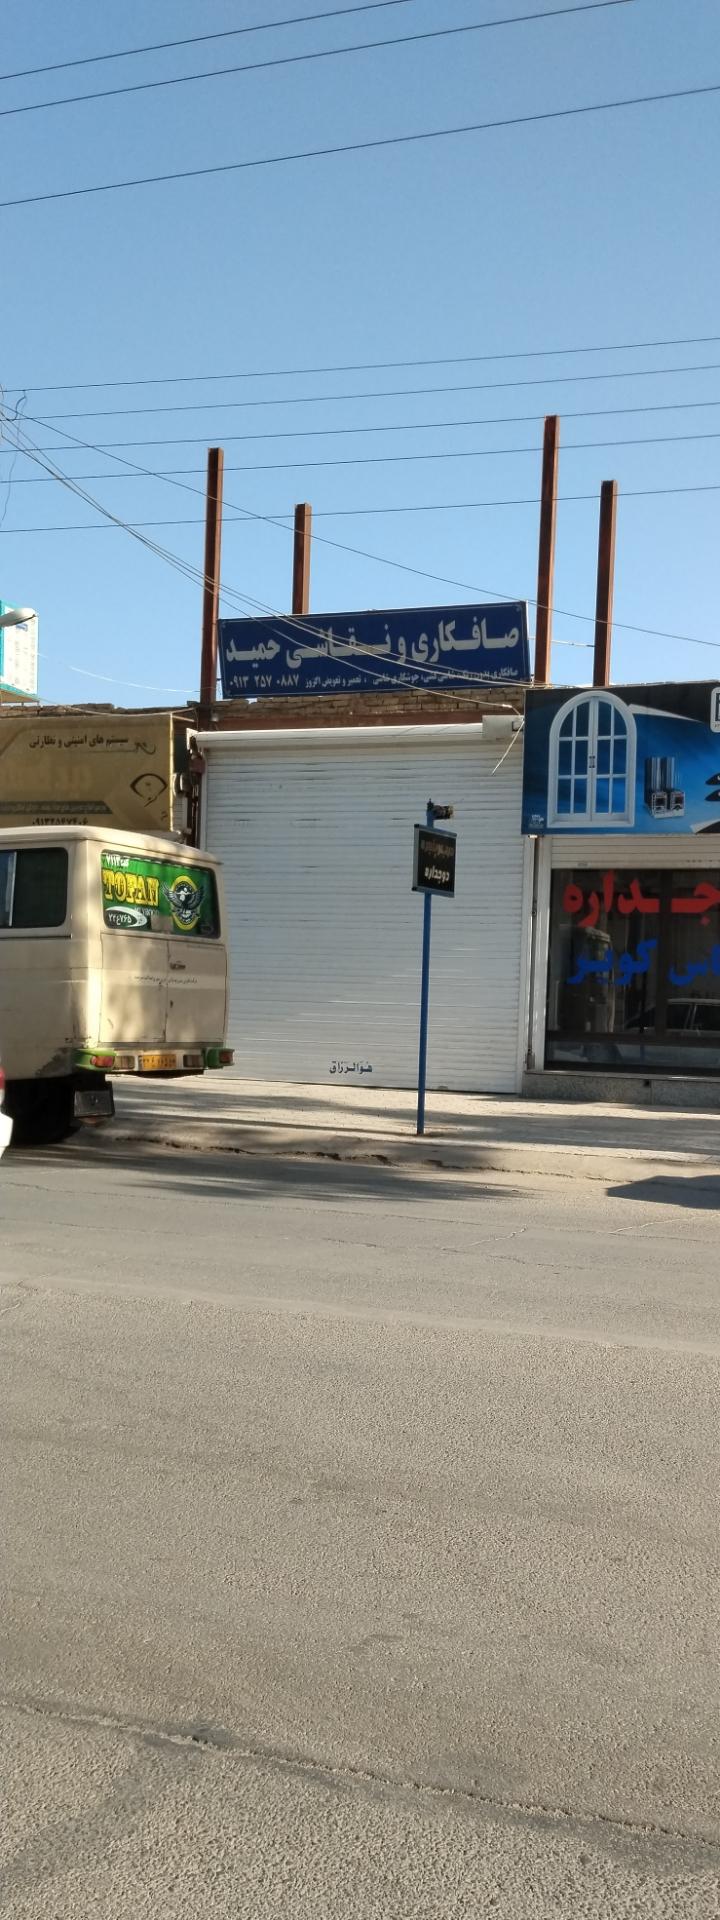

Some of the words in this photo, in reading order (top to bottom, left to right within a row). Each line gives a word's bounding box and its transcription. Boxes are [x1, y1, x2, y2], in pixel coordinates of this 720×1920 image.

[226, 638, 281, 669] حمید
[397, 635, 407, 665] و
[411, 616, 520, 663] صافکاری
[229, 675, 249, 689] ۰۹۱۳
[254, 675, 272, 688] ۲۵۷
[276, 674, 300, 687] ۰۸۸۷
[88, 734, 105, 747] های
[105, 735, 129, 747] سیستم
[101, 869, 159, 907] TOFAN
[566, 939, 658, 986] کویر
